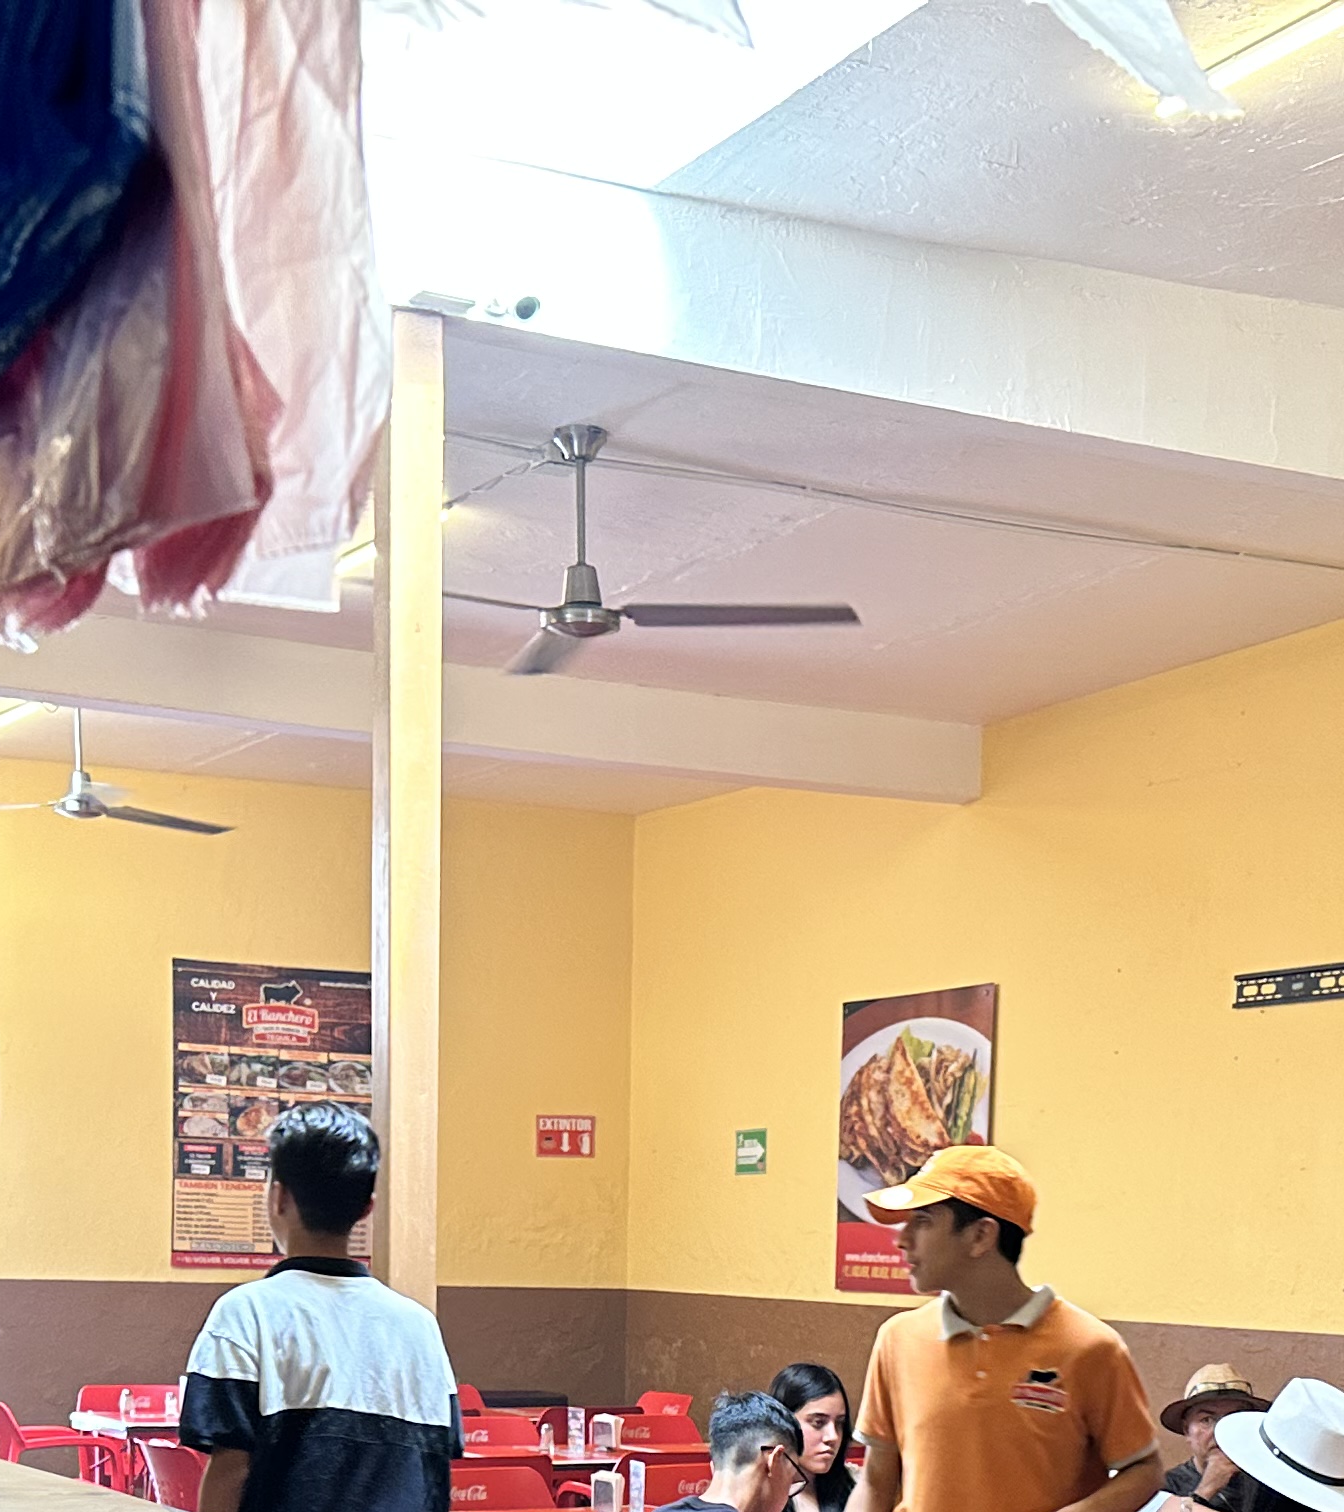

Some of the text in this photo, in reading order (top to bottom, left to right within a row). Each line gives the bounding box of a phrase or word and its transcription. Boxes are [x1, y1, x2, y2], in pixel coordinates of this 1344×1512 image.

[190, 977, 236, 990] CALIDAD
[209, 991, 218, 1001] Y
[191, 1001, 237, 1015] CALIDEZ
[539, 1118, 592, 1131] EXTINTOR
